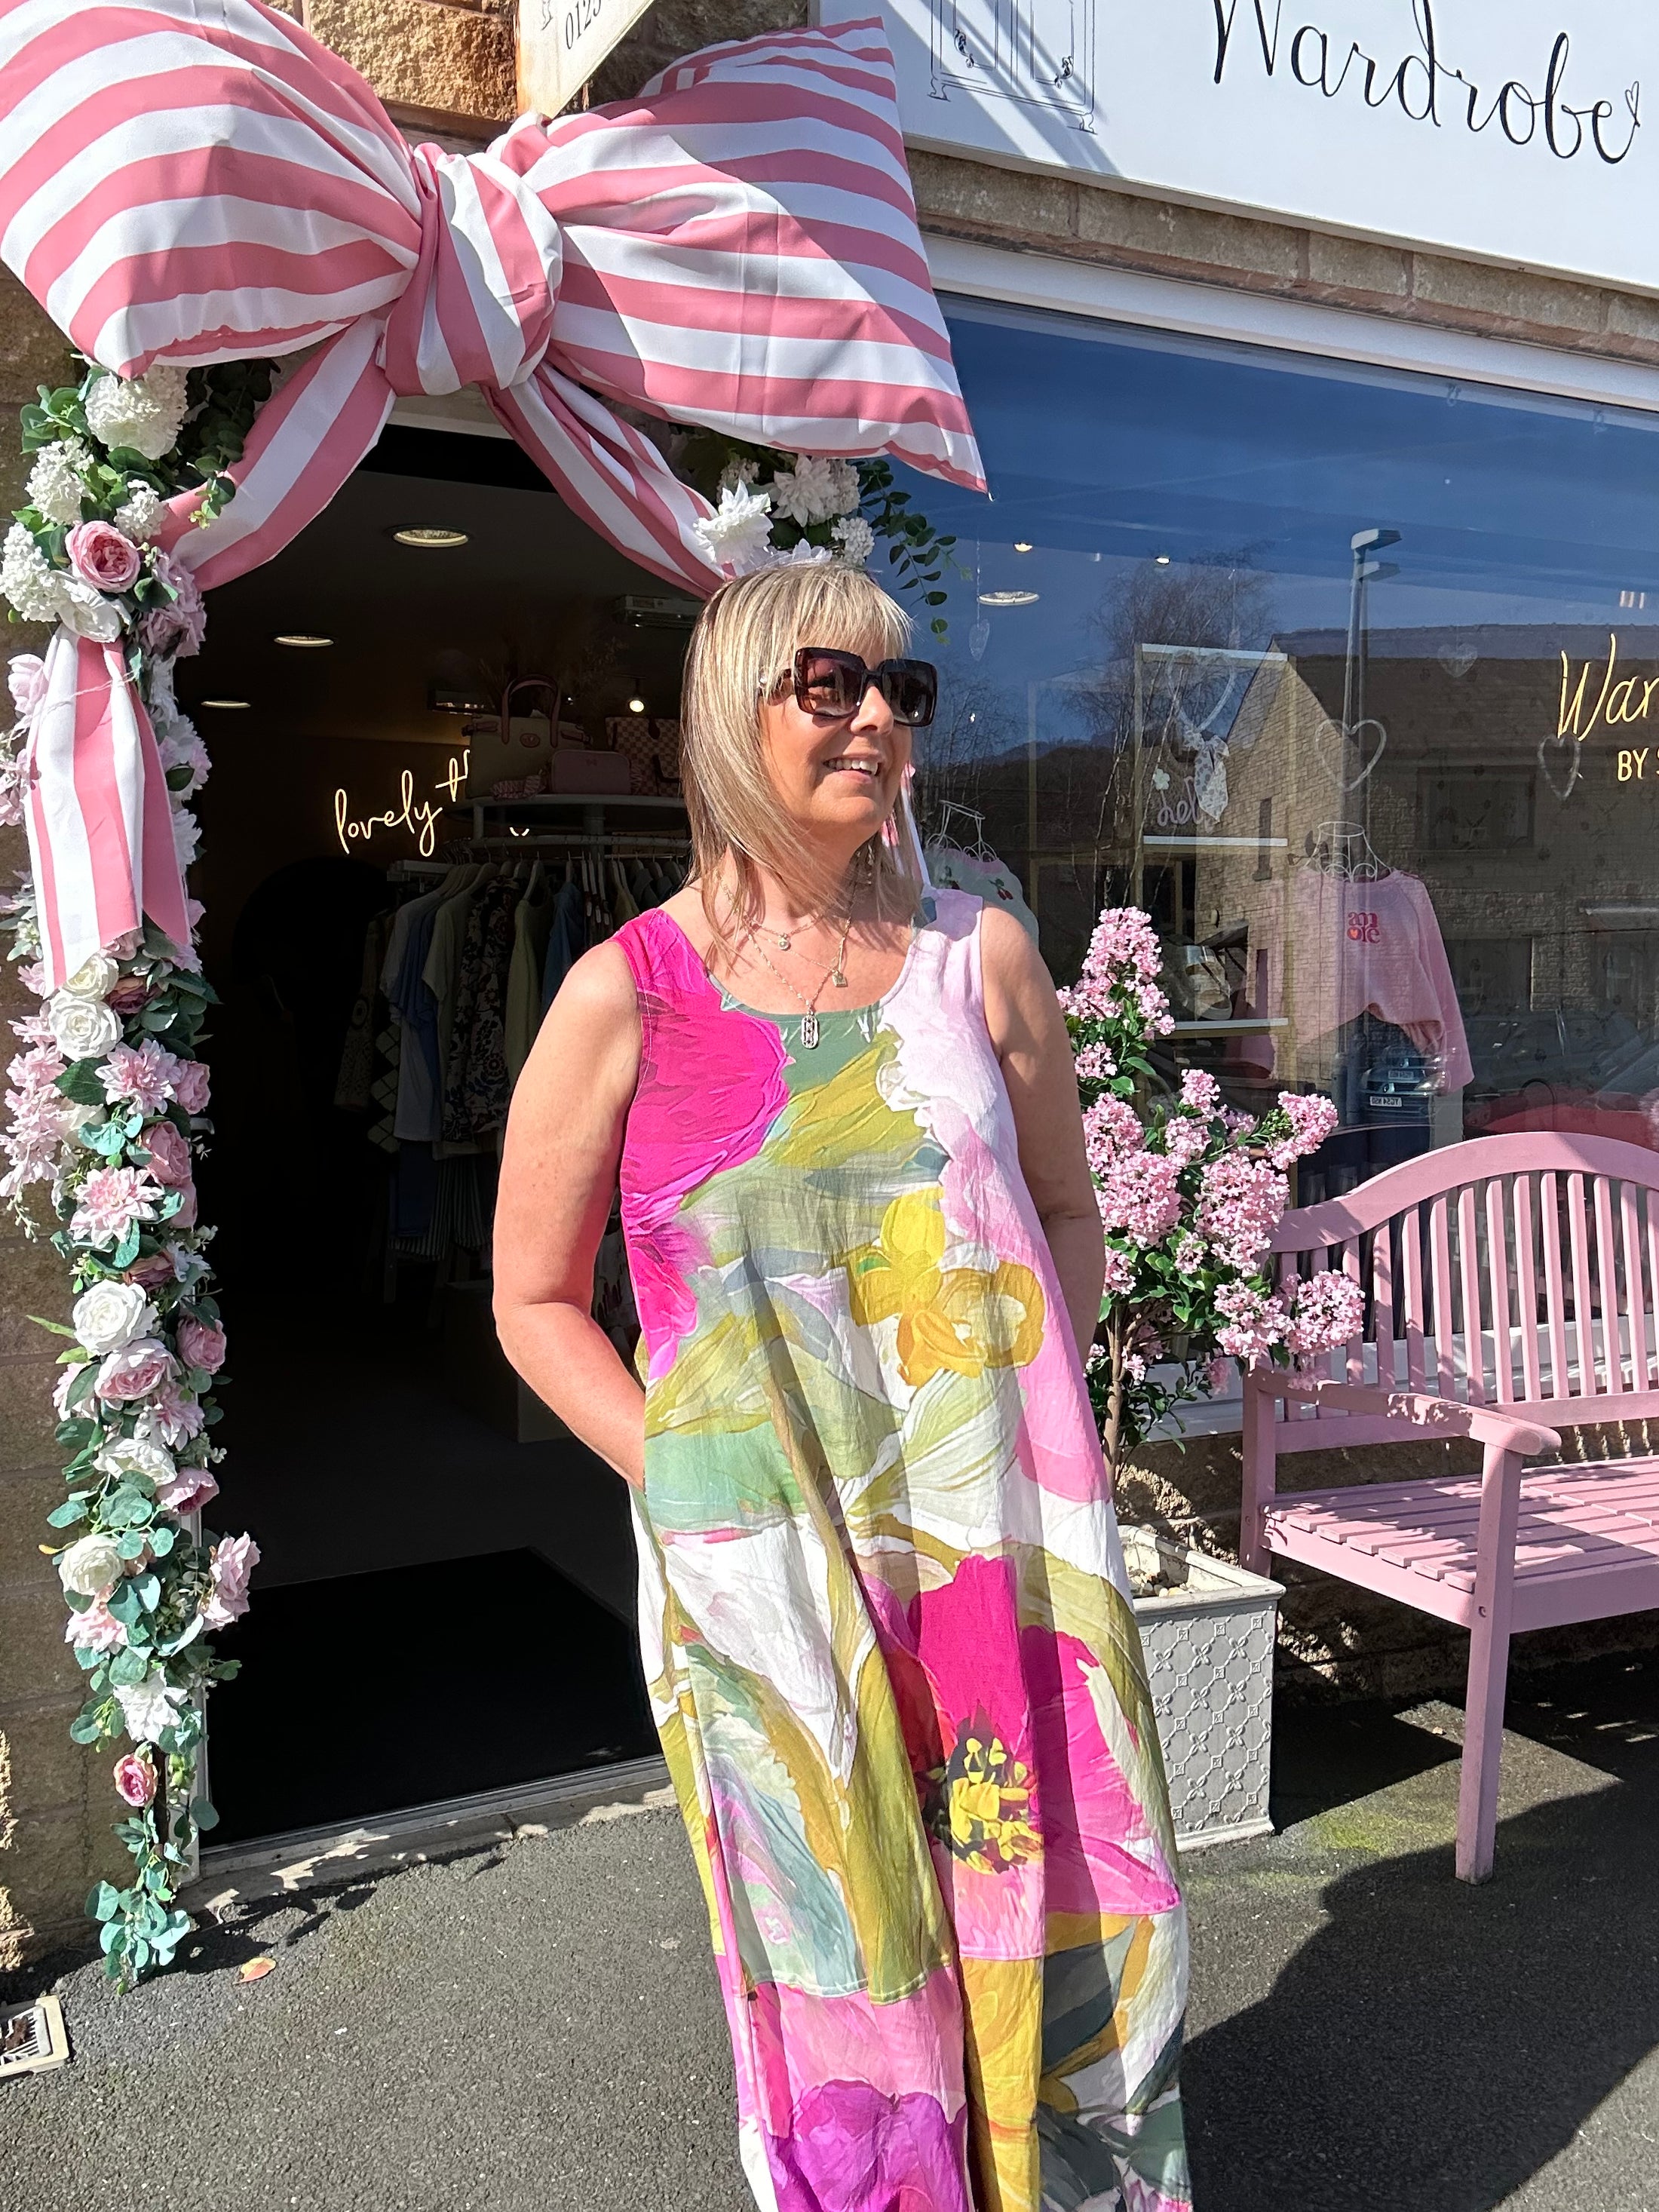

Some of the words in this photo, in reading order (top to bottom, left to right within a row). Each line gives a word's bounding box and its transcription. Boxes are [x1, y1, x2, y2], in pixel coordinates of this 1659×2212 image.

[1214, 0, 1640, 164] Wardrobe
[1618, 747, 1650, 781] BY
[335, 769, 443, 857] lovely
